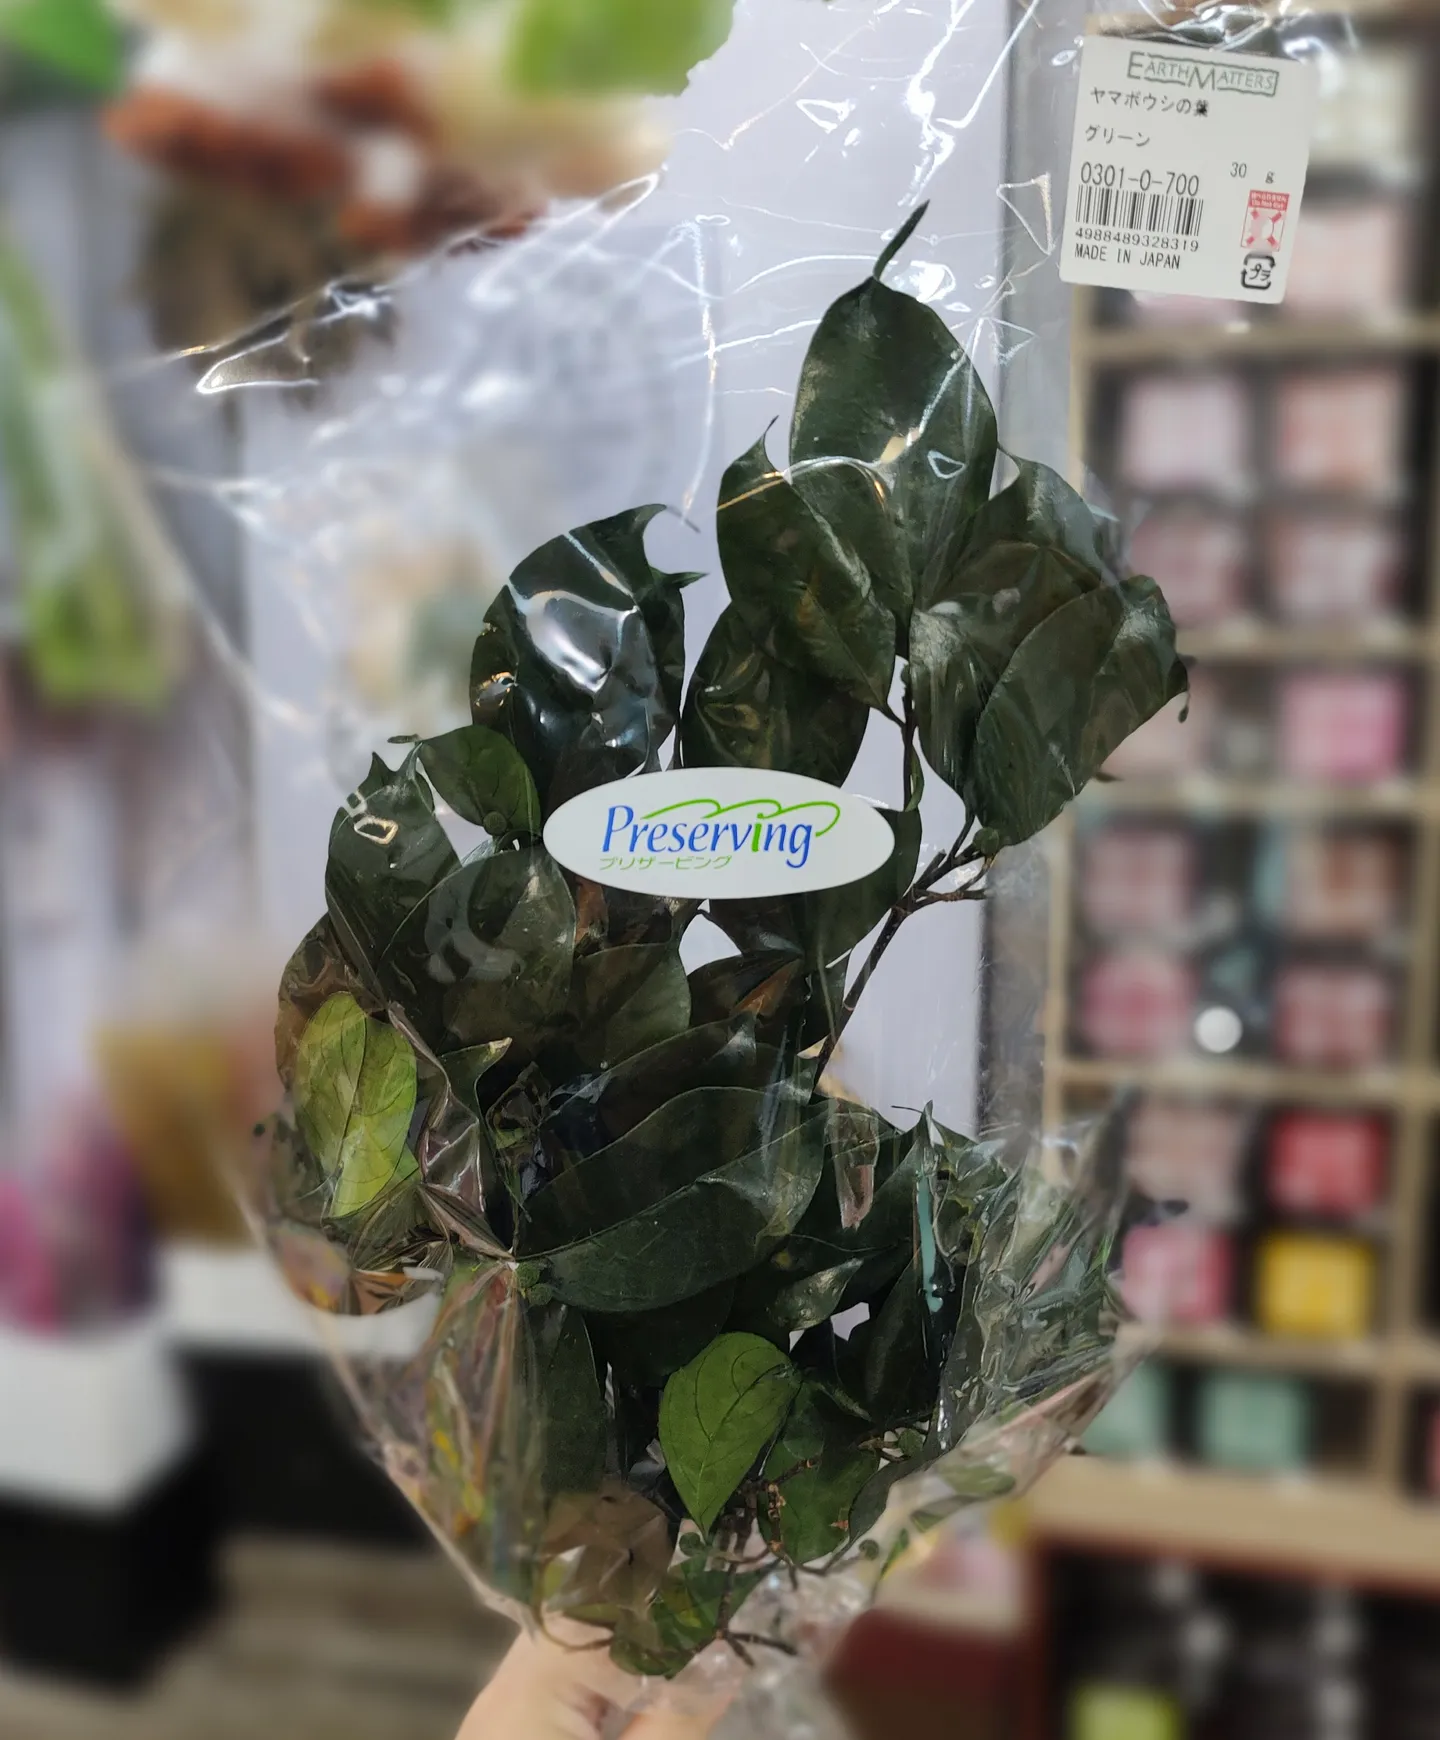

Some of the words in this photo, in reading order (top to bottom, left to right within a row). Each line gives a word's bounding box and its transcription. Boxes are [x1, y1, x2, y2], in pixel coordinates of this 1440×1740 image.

[1085, 125, 1150, 147] グリーン
[1080, 161, 1200, 196] 0301-0-700
[1229, 162, 1247, 178] 30
[1075, 228, 1199, 252] 4988489328319
[1074, 243, 1108, 261] MADE
[1117, 248, 1131, 263] IN
[1140, 250, 1180, 270] JAPAN
[602, 804, 814, 869] Preserving
